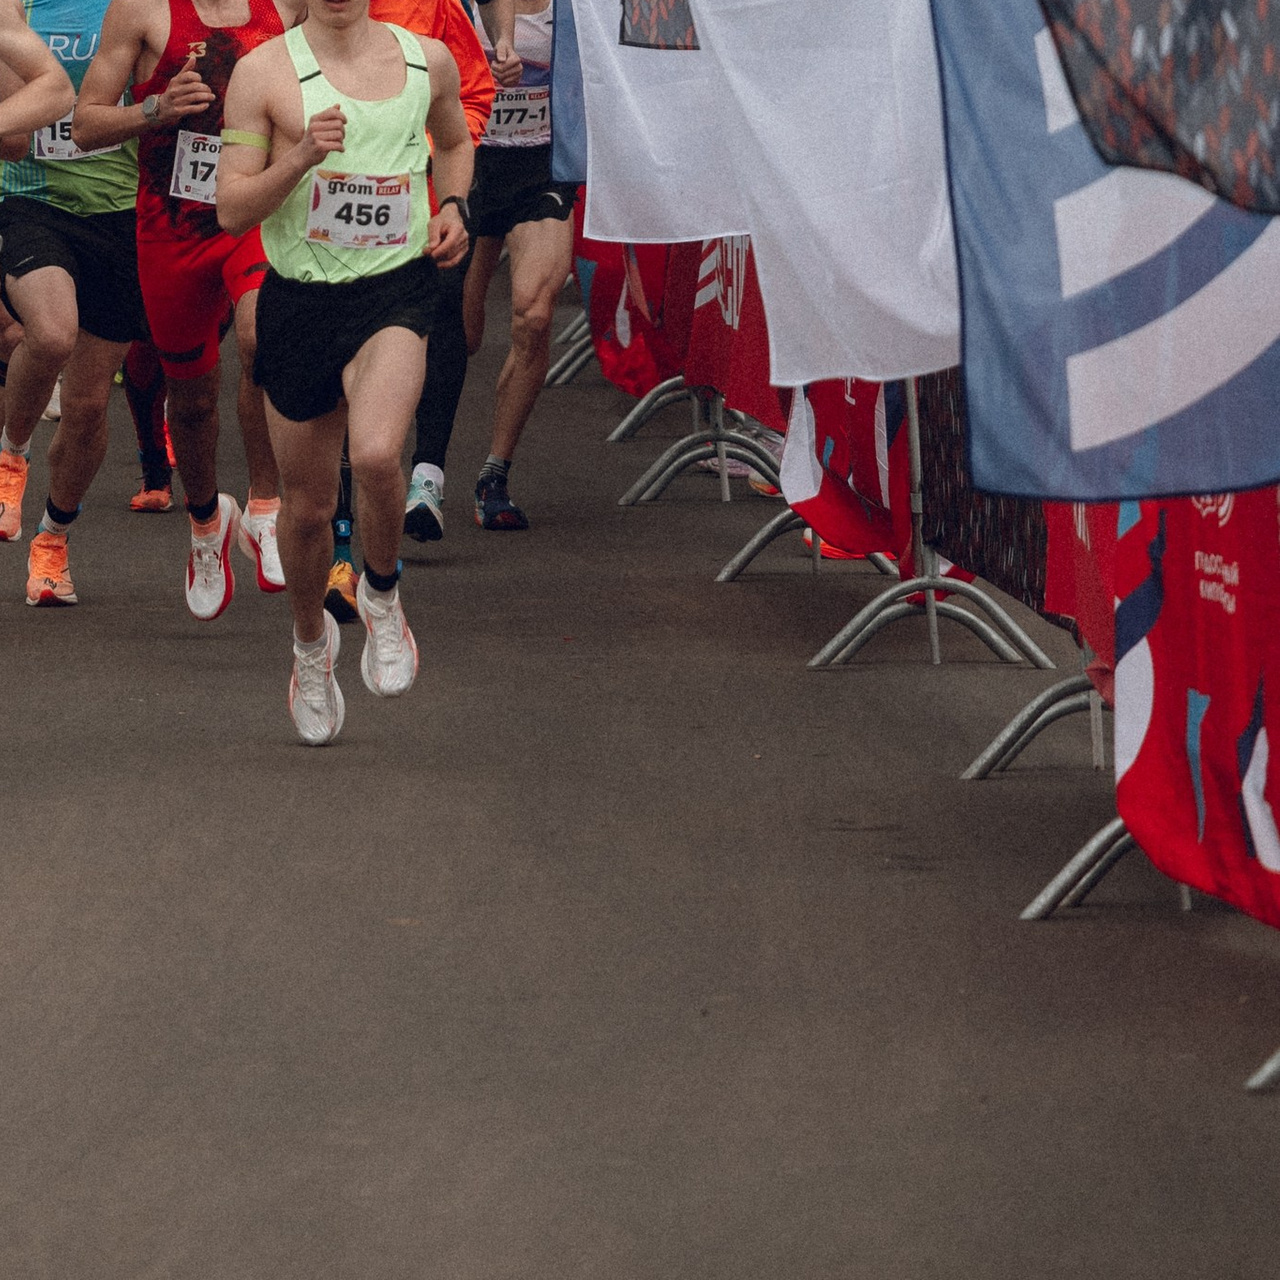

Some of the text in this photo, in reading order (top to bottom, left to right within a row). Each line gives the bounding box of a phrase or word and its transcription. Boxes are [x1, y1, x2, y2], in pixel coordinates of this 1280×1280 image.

[49, 33, 98, 61] RU
[493, 105, 547, 125] 177-1
[47, 121, 73, 141] 15
[191, 139, 222, 155] gro
[188, 160, 218, 183] 17
[327, 180, 400, 196] grom RELAY
[334, 202, 391, 227] 456
